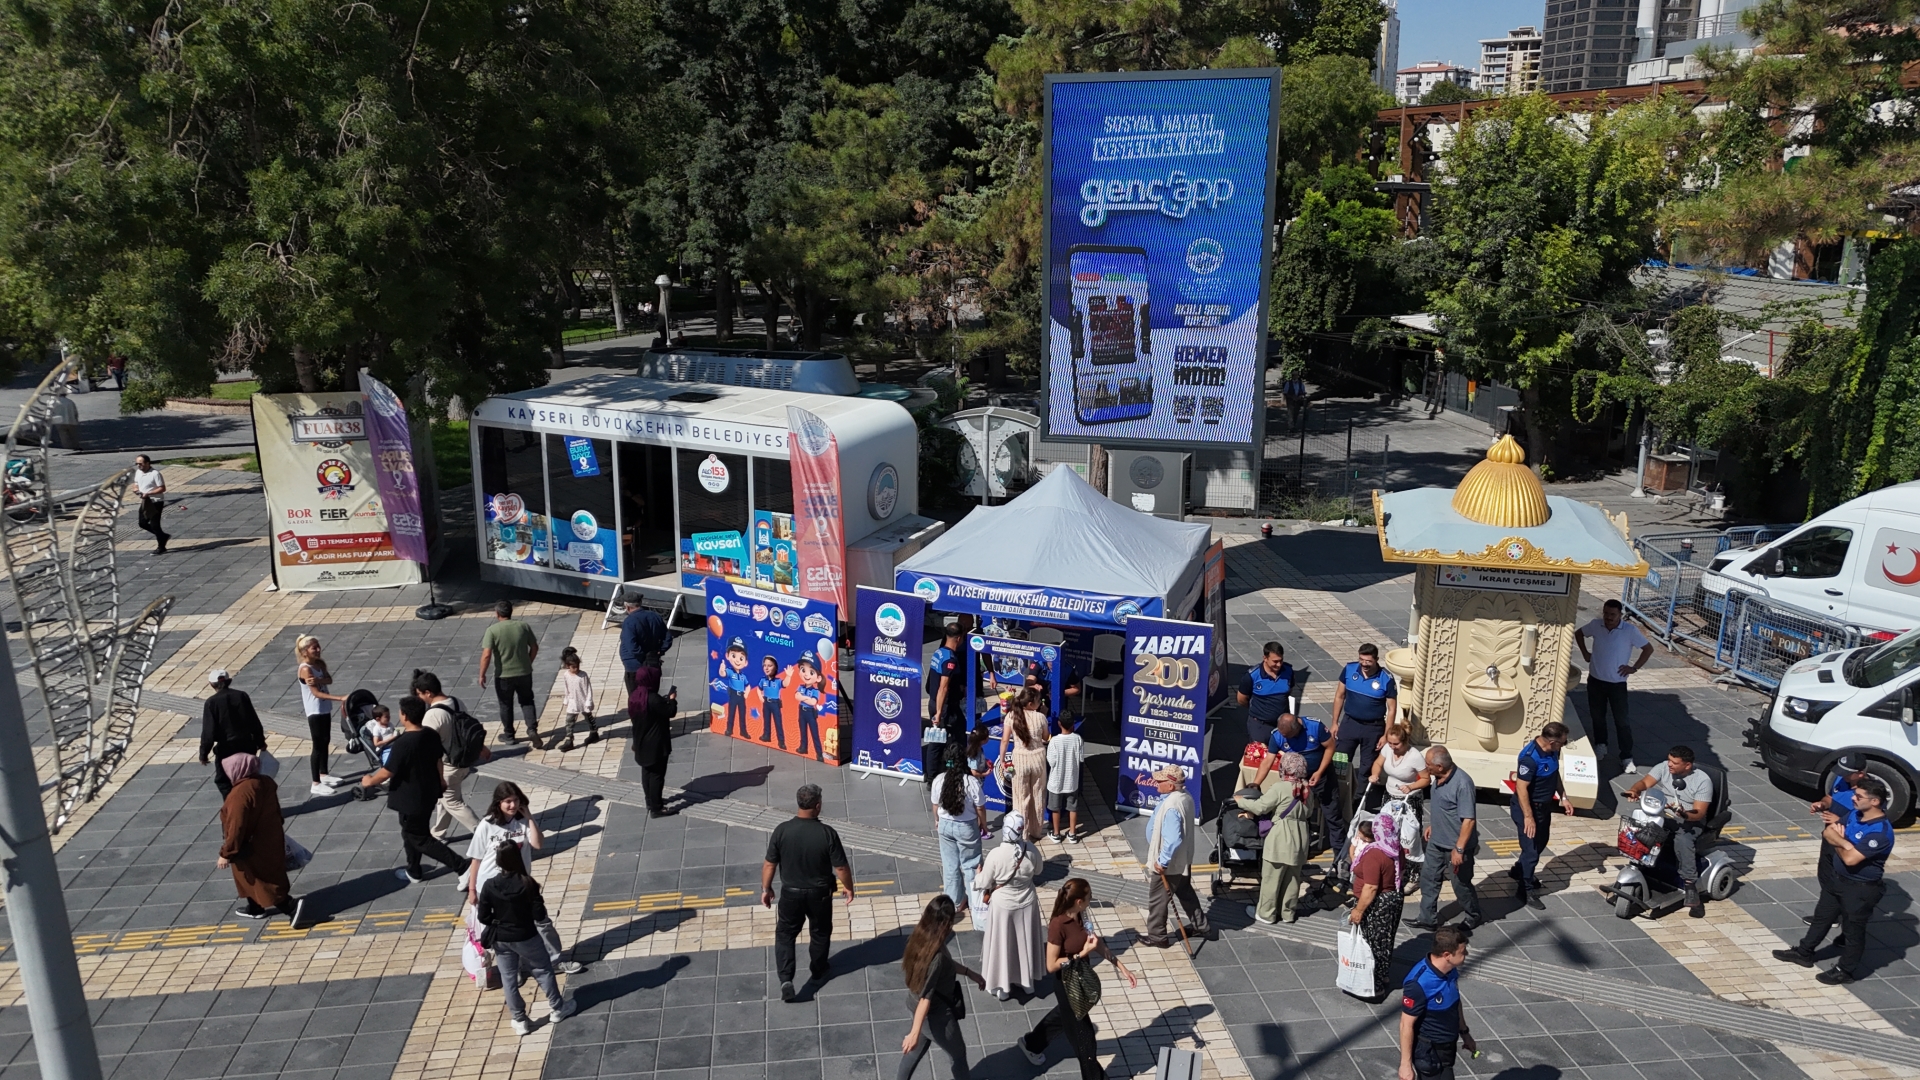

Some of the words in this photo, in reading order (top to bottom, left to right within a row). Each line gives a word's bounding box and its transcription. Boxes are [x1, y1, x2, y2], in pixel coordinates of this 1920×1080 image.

[1103, 115, 1156, 133] SOSYAL
[1161, 113, 1214, 132] HAYATI
[1174, 345, 1227, 363] HEMEN
[303, 421, 361, 435] FUAR38
[508, 406, 573, 425] KAYSERİ
[582, 414, 684, 436] BÜYÜKŞEHİR
[569, 444, 591, 455] BURA-
[287, 508, 312, 519] BOR
[336, 551, 352, 559] HAS
[1478, 574, 1511, 584] İKRAM
[1512, 577, 1556, 587] ÇEŞMESİ
[946, 584, 989, 600] KAYSERİ
[988, 587, 1050, 607] BÜYÜKŞEHİR
[1049, 596, 1107, 614] BELEDİYESİ
[1131, 635, 1205, 655] ZABITA
[1777, 637, 1808, 656] POLİS
[1133, 653, 1200, 690] 200
[1132, 685, 1196, 715] Yaşında
[1158, 731, 1177, 741] EYLÜL
[1124, 736, 1200, 765] ZABITA
[1128, 755, 1194, 780] HAFTSI
